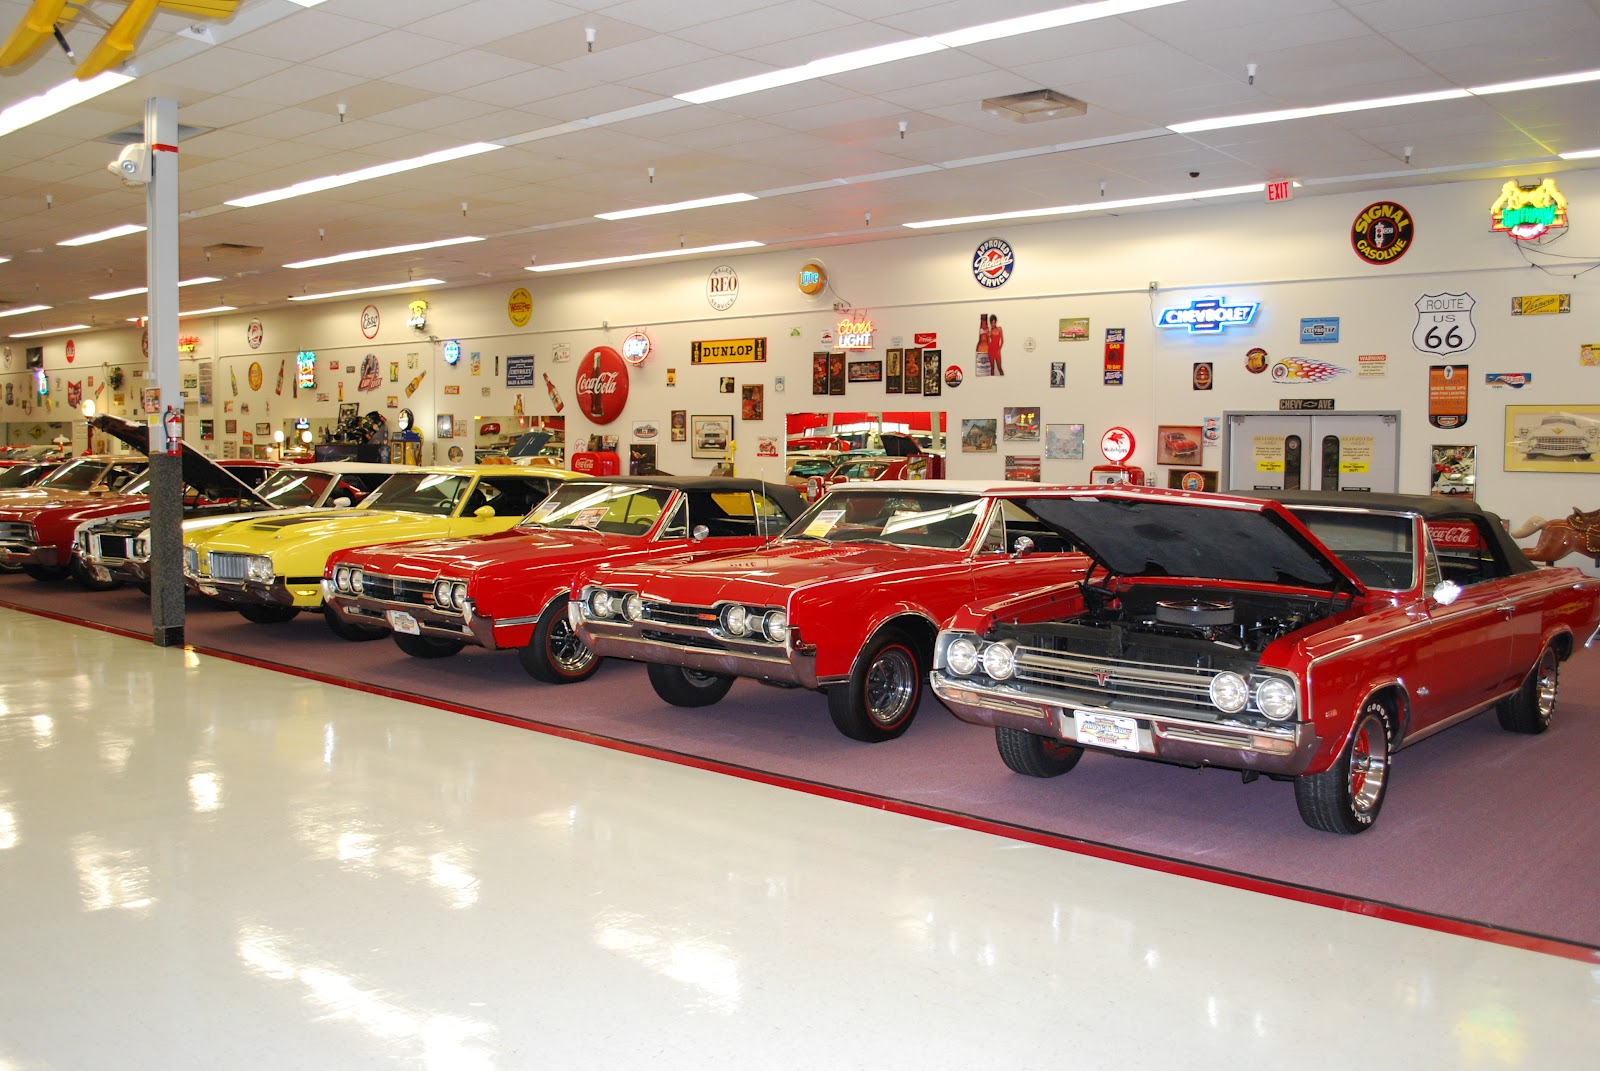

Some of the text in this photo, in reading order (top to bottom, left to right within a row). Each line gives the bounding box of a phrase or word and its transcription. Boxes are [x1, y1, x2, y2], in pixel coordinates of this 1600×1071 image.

[1268, 181, 1289, 201] EXIT
[1355, 205, 1409, 234] SIGNAL
[977, 240, 1010, 256] APPROVED
[1357, 238, 1406, 261] GASOLINE
[974, 252, 1013, 273] Packard
[713, 267, 732, 276] SALES
[800, 271, 819, 286] Lite
[977, 271, 1009, 286] SERVICE
[710, 276, 737, 292] REO
[711, 297, 734, 309] SERVICE
[1426, 298, 1464, 310] ROUTE
[362, 313, 378, 329] Esso
[1165, 307, 1250, 323] CHEVROLET
[1433, 314, 1456, 323] US
[837, 319, 873, 335] Coors
[1303, 326, 1335, 334] CHEVROLET
[838, 333, 871, 348] LIGHT
[1424, 325, 1463, 349] 66
[703, 345, 753, 357] DUNLOP
[577, 371, 619, 395] Coca-Cola
[1280, 399, 1334, 409] CHEVY AVE.
[1104, 446, 1127, 454] Mobilgas
[1367, 703, 1392, 765] GOODYEAR
